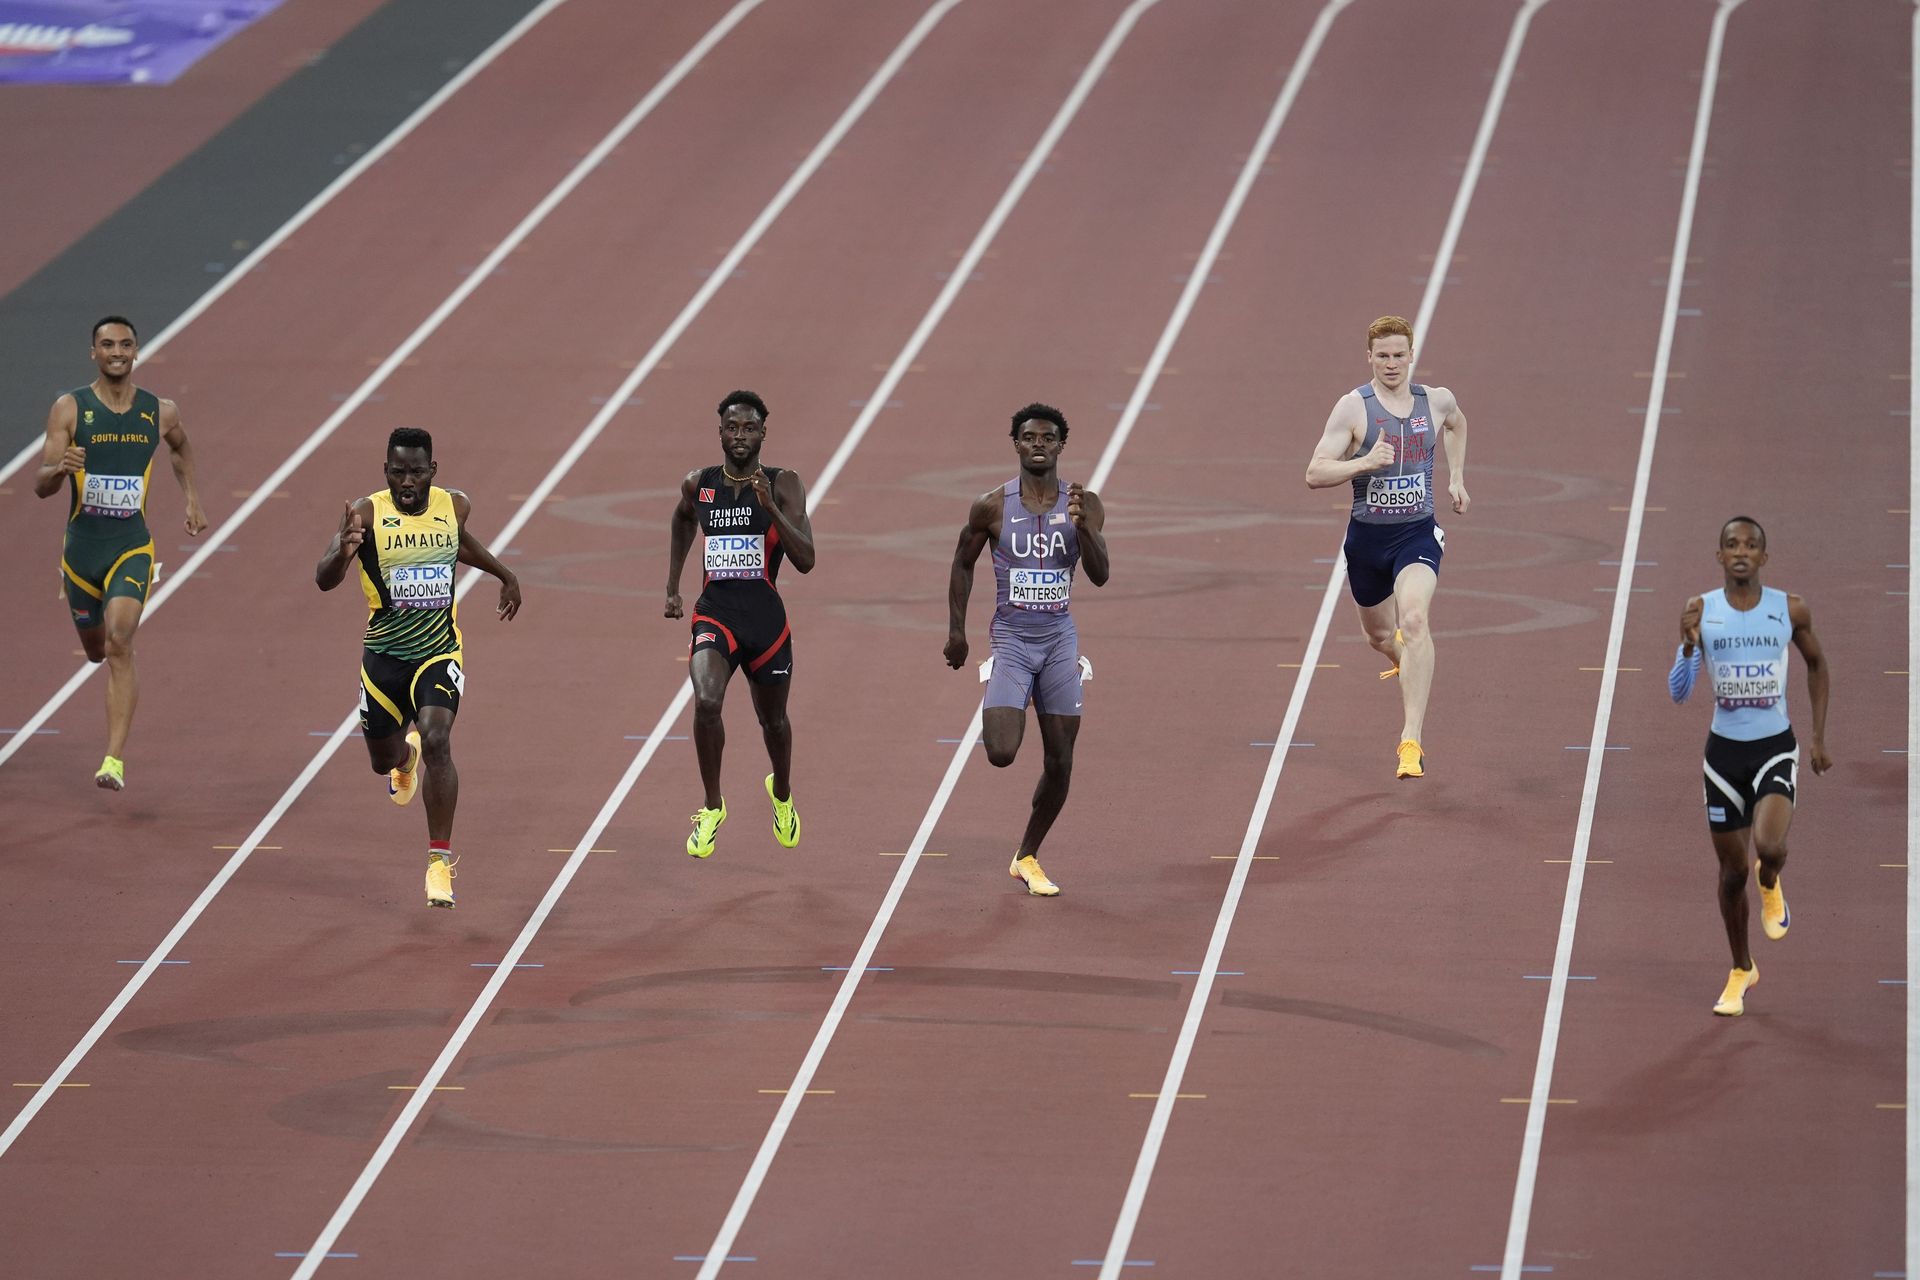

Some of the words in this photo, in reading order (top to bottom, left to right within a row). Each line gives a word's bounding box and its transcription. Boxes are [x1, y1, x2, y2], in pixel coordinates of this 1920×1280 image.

[91, 433, 118, 444] SOUTH
[121, 433, 149, 444] AFRICA
[100, 477, 139, 491] TDK
[1384, 475, 1421, 490] TDK
[86, 491, 140, 507] PILLAY
[1370, 490, 1423, 505] DOBSON
[710, 506, 752, 519] TRINIDAD
[384, 533, 454, 550] JAMAICA
[719, 537, 759, 551] TDK
[1011, 531, 1067, 558] USA
[707, 553, 762, 568] RICHARDS
[408, 566, 448, 580] TDK
[1027, 570, 1067, 584] TDK
[1013, 585, 1068, 600] PATTERSON
[1713, 636, 1780, 650] BOTSWANA
[1731, 662, 1774, 678] TDK
[1716, 680, 1779, 696] KEBINATSHIPI
